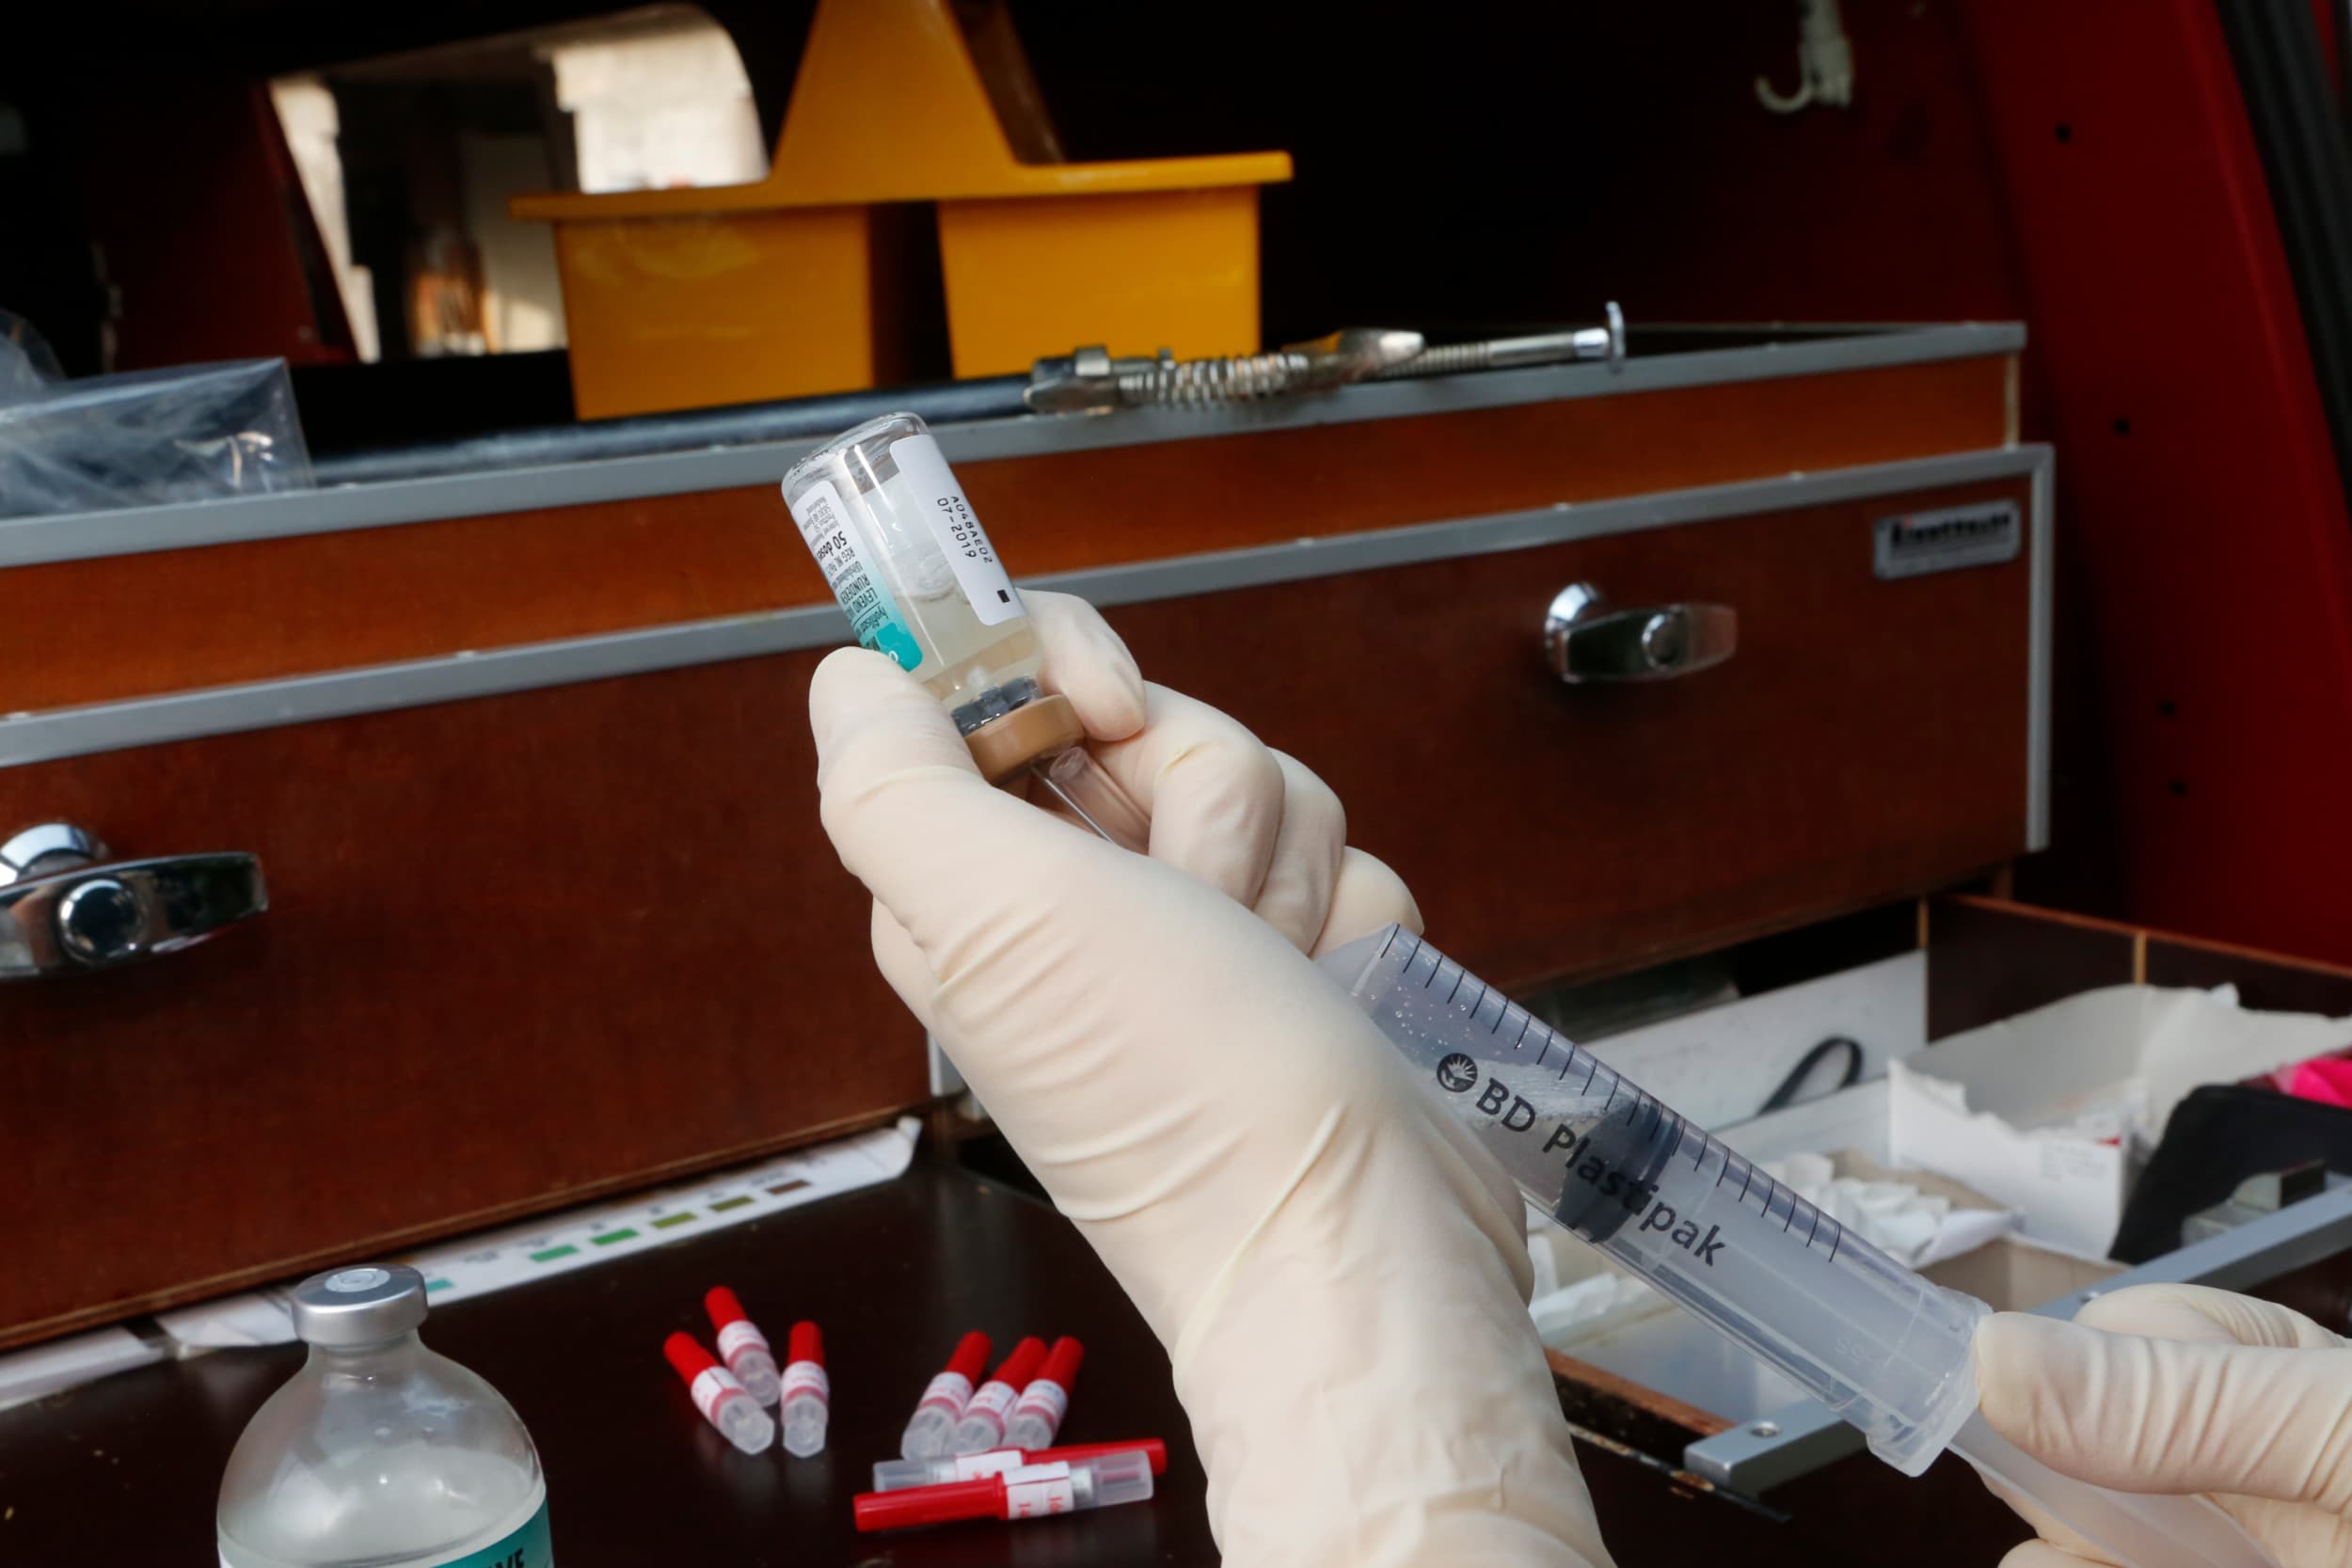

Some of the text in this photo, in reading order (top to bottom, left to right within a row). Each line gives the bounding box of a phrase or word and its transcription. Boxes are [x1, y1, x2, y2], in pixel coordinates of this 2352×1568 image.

[833, 531, 848, 549] 50
[937, 498, 977, 558] 07-2019
[1476, 1078, 1725, 1267] BD Plastipak
